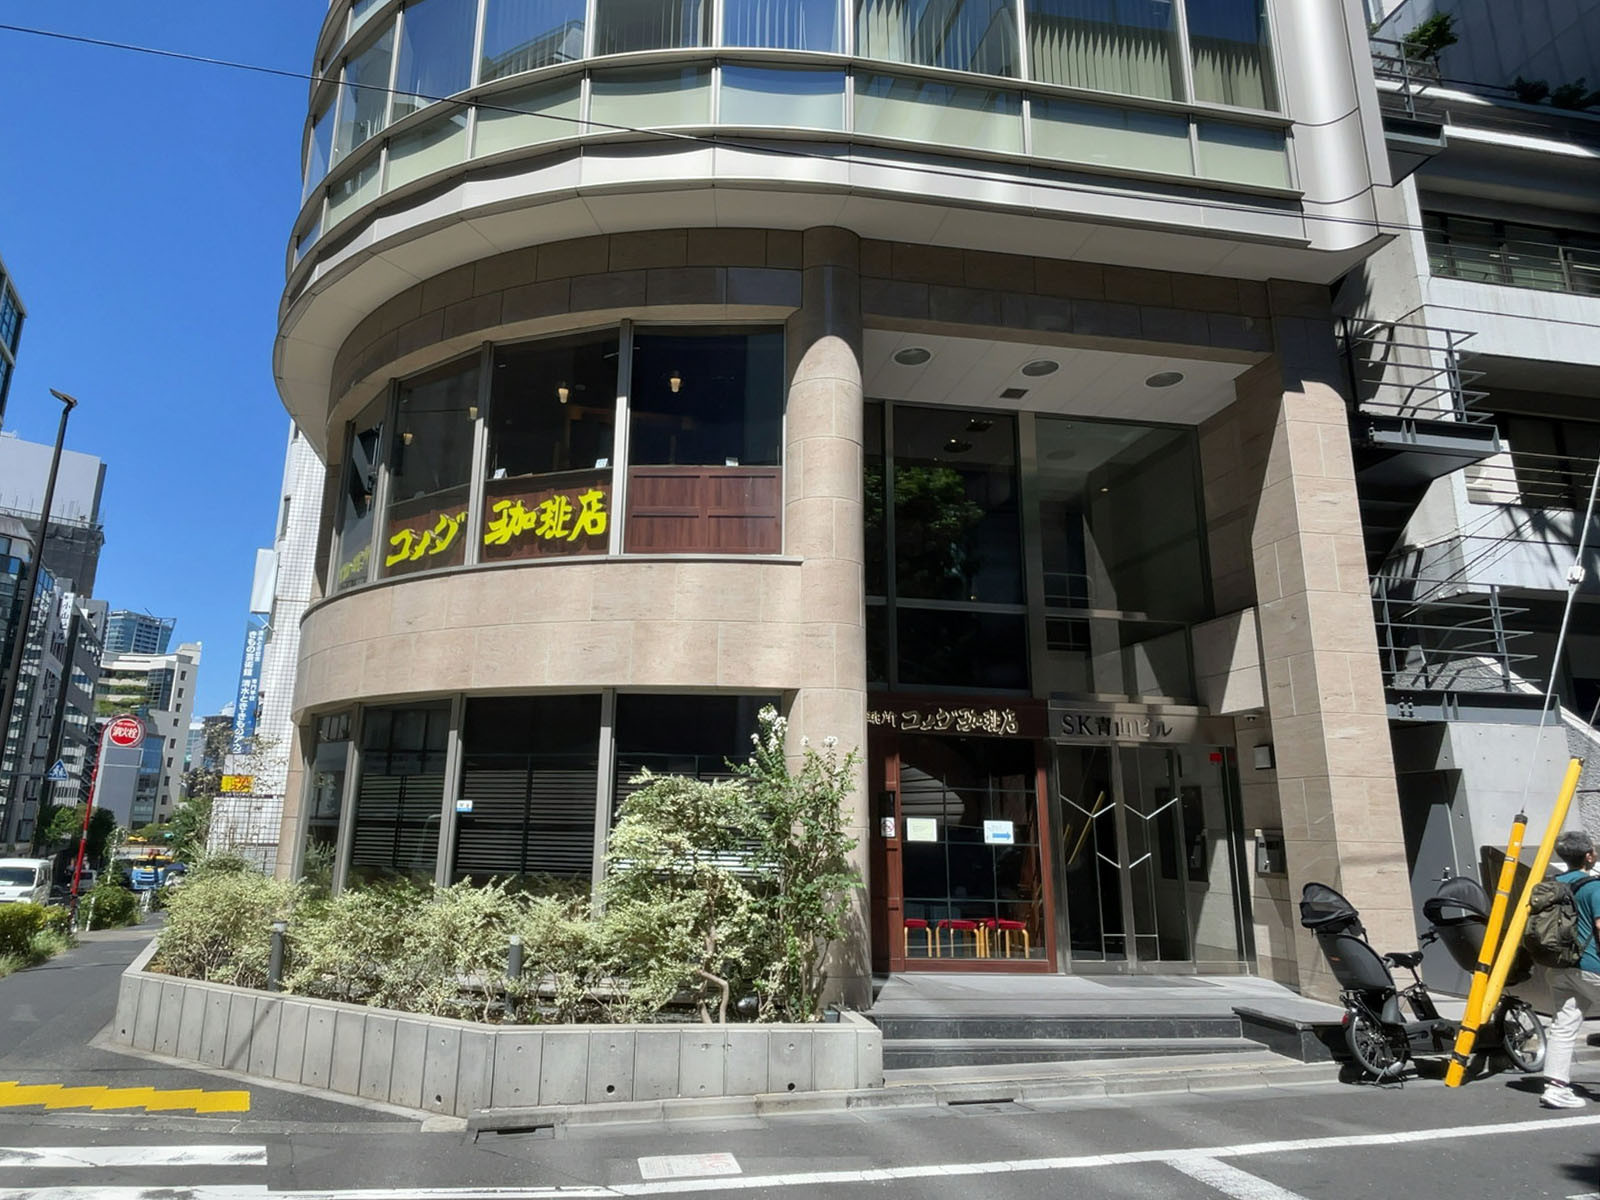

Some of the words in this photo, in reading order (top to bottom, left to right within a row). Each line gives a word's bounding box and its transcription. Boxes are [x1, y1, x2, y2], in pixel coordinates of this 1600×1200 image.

[385, 511, 468, 567] コメダ
[484, 488, 607, 545] 珈琲店
[111, 725, 138, 739] 消火栓
[1061, 714, 1173, 737] SK青山ビル
